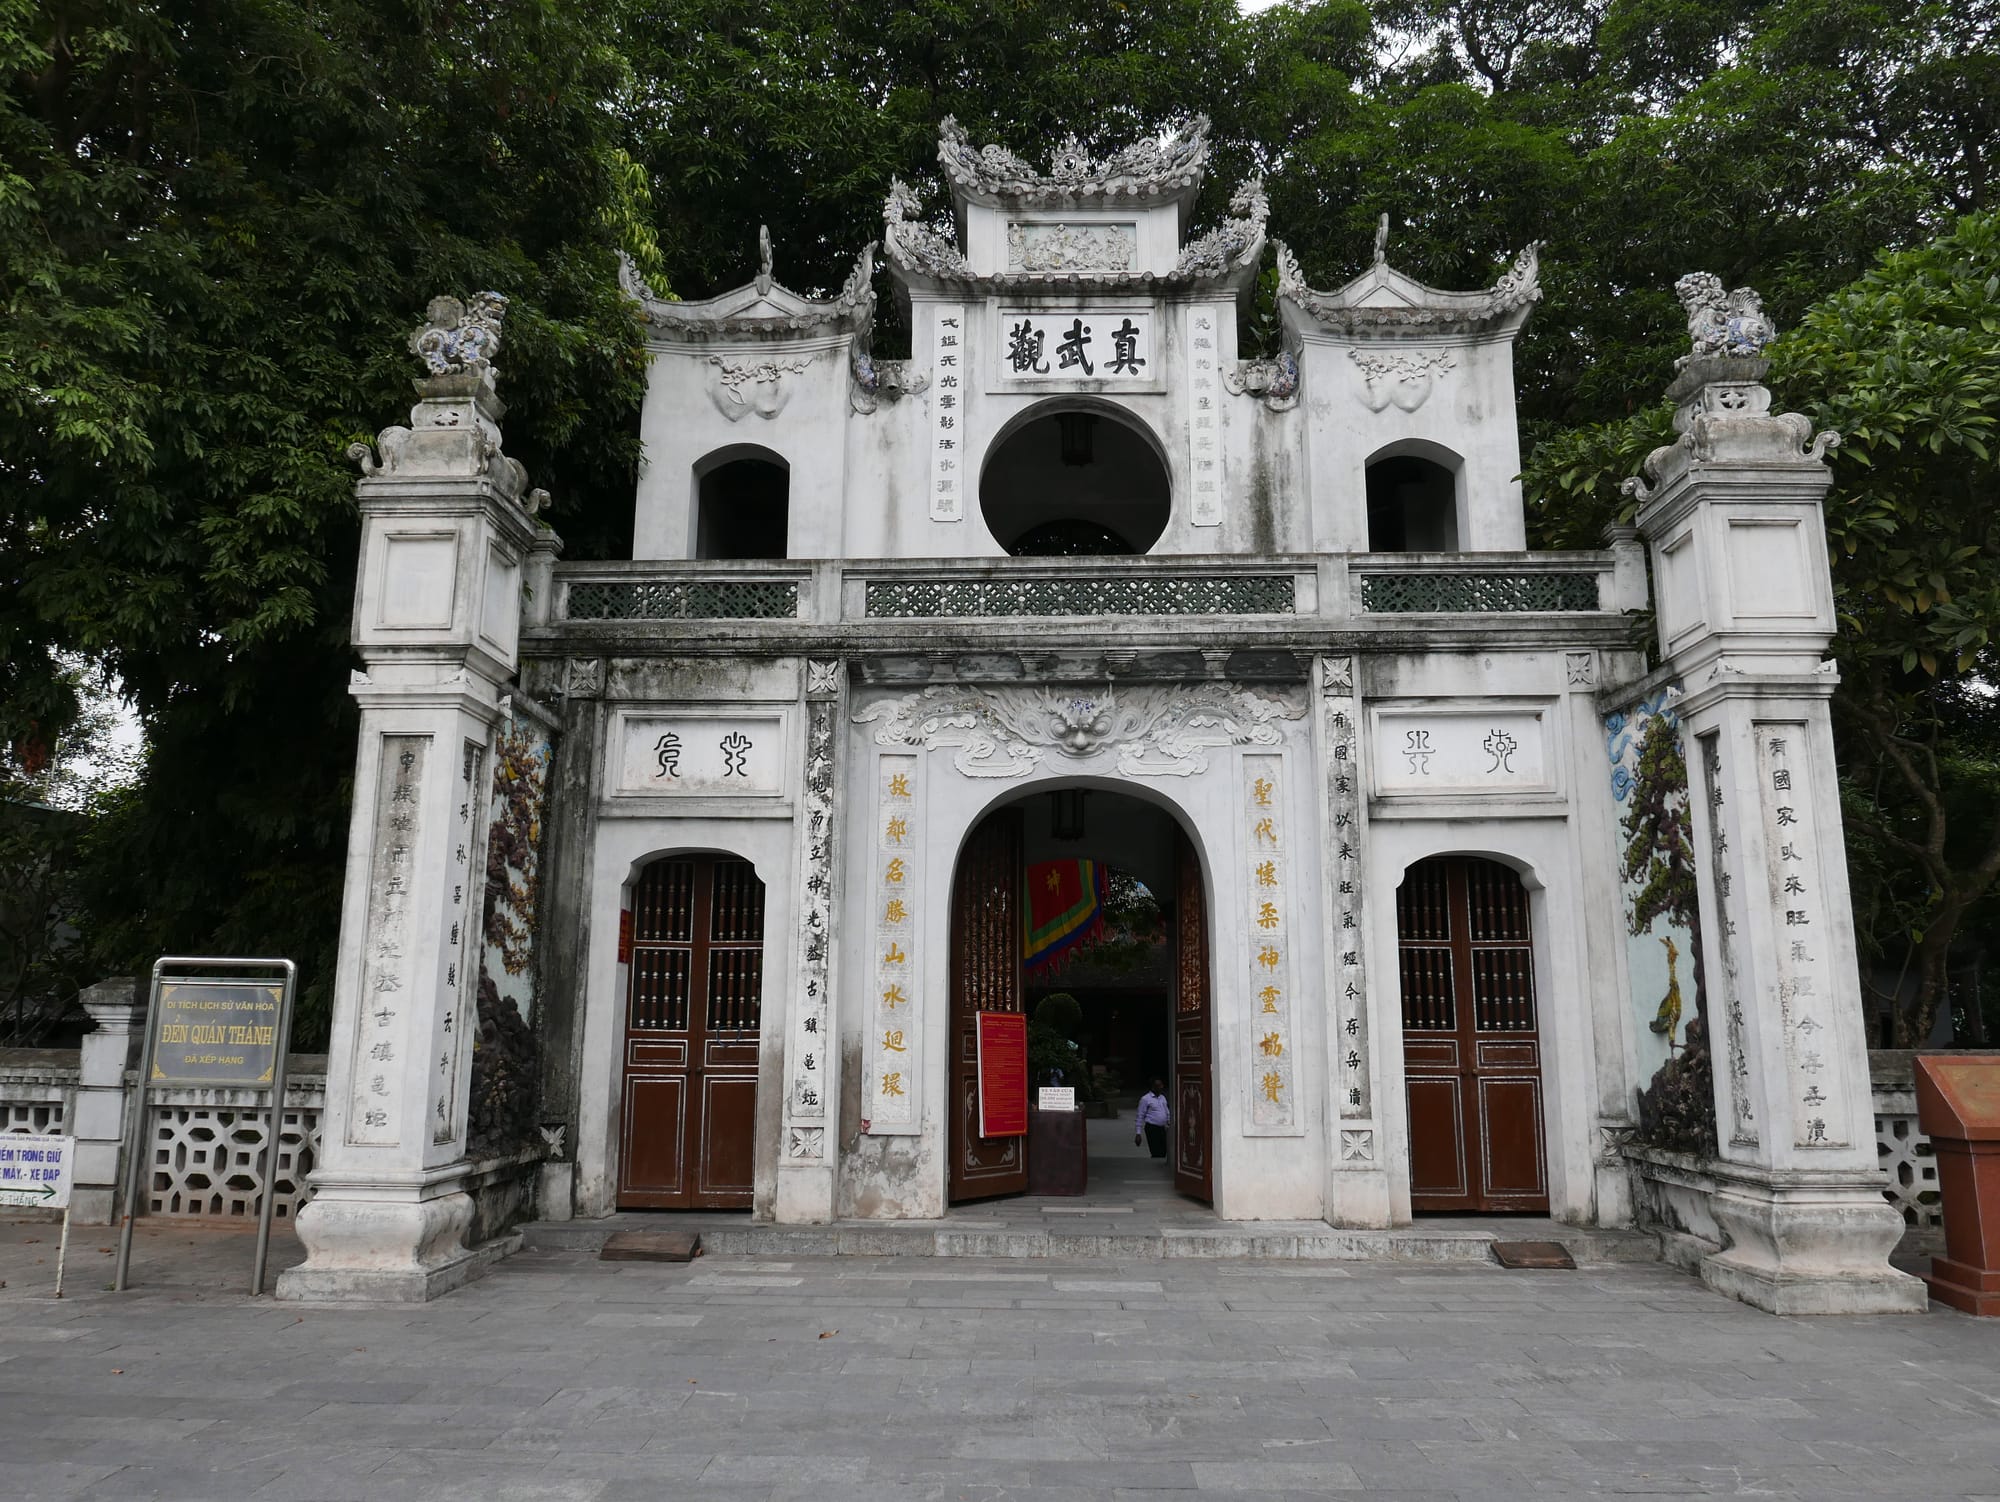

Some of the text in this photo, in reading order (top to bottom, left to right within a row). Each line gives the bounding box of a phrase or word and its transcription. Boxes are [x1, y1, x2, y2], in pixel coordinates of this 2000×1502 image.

[167, 1001, 176, 1009] DI
[191, 1018, 229, 1045] QUÁN
[228, 1019, 273, 1045] THÁNH
[30, 1168, 41, 1181] XE
